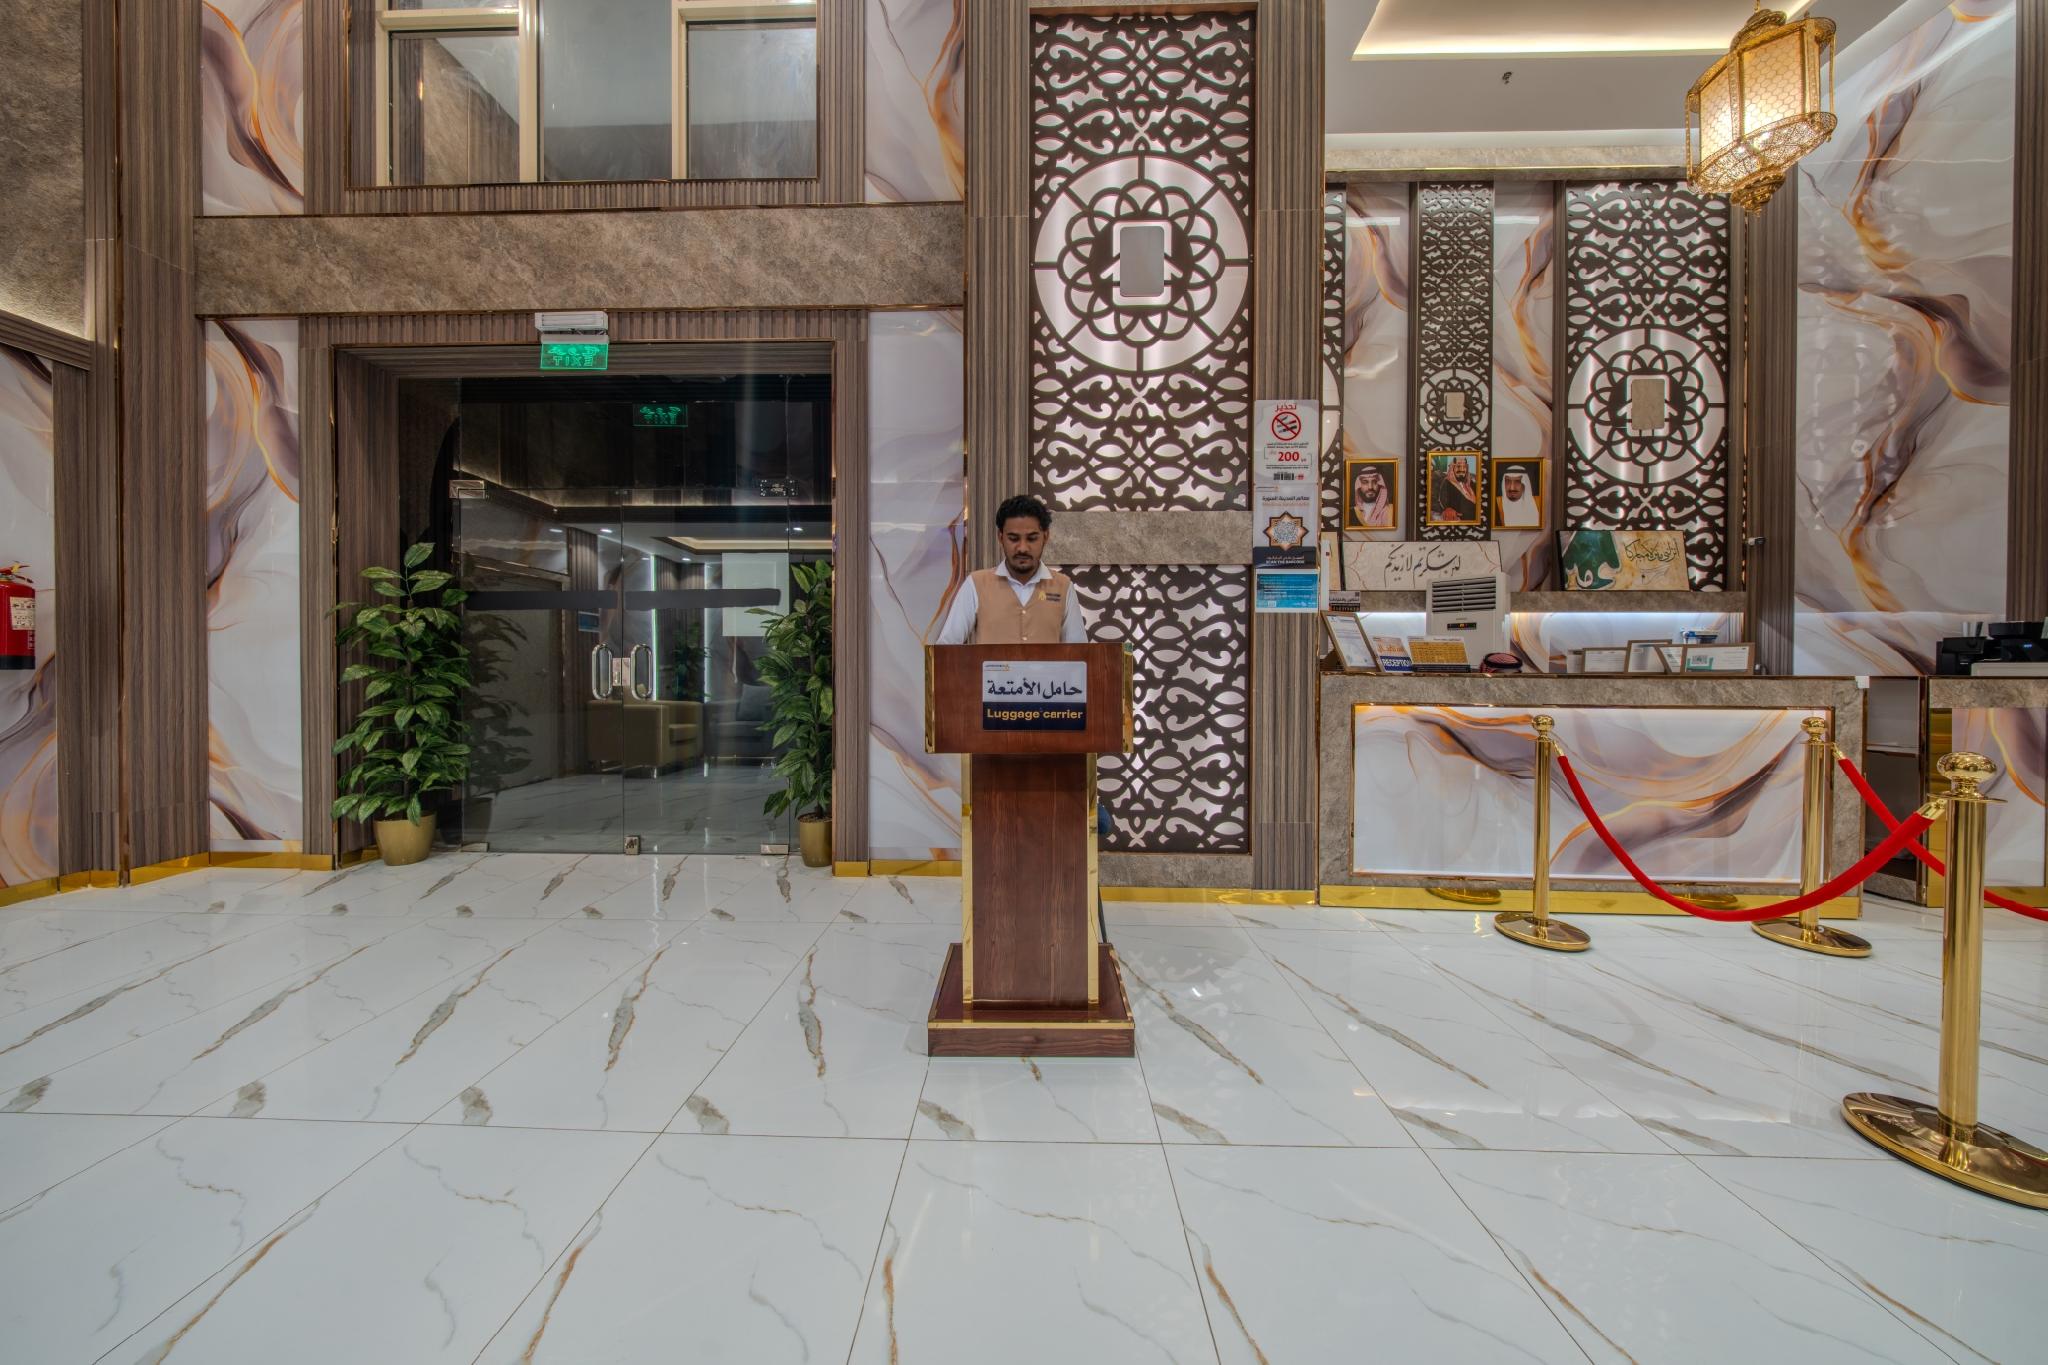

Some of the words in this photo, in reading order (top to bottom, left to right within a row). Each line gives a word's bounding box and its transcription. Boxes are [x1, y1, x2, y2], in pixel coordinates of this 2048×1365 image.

[1278, 451, 1300, 462] 200
[987, 677, 1041, 696] الأمتعة
[1042, 680, 1083, 700] حامل
[987, 708, 1040, 721] Luggage
[1042, 709, 1083, 719] carrier
